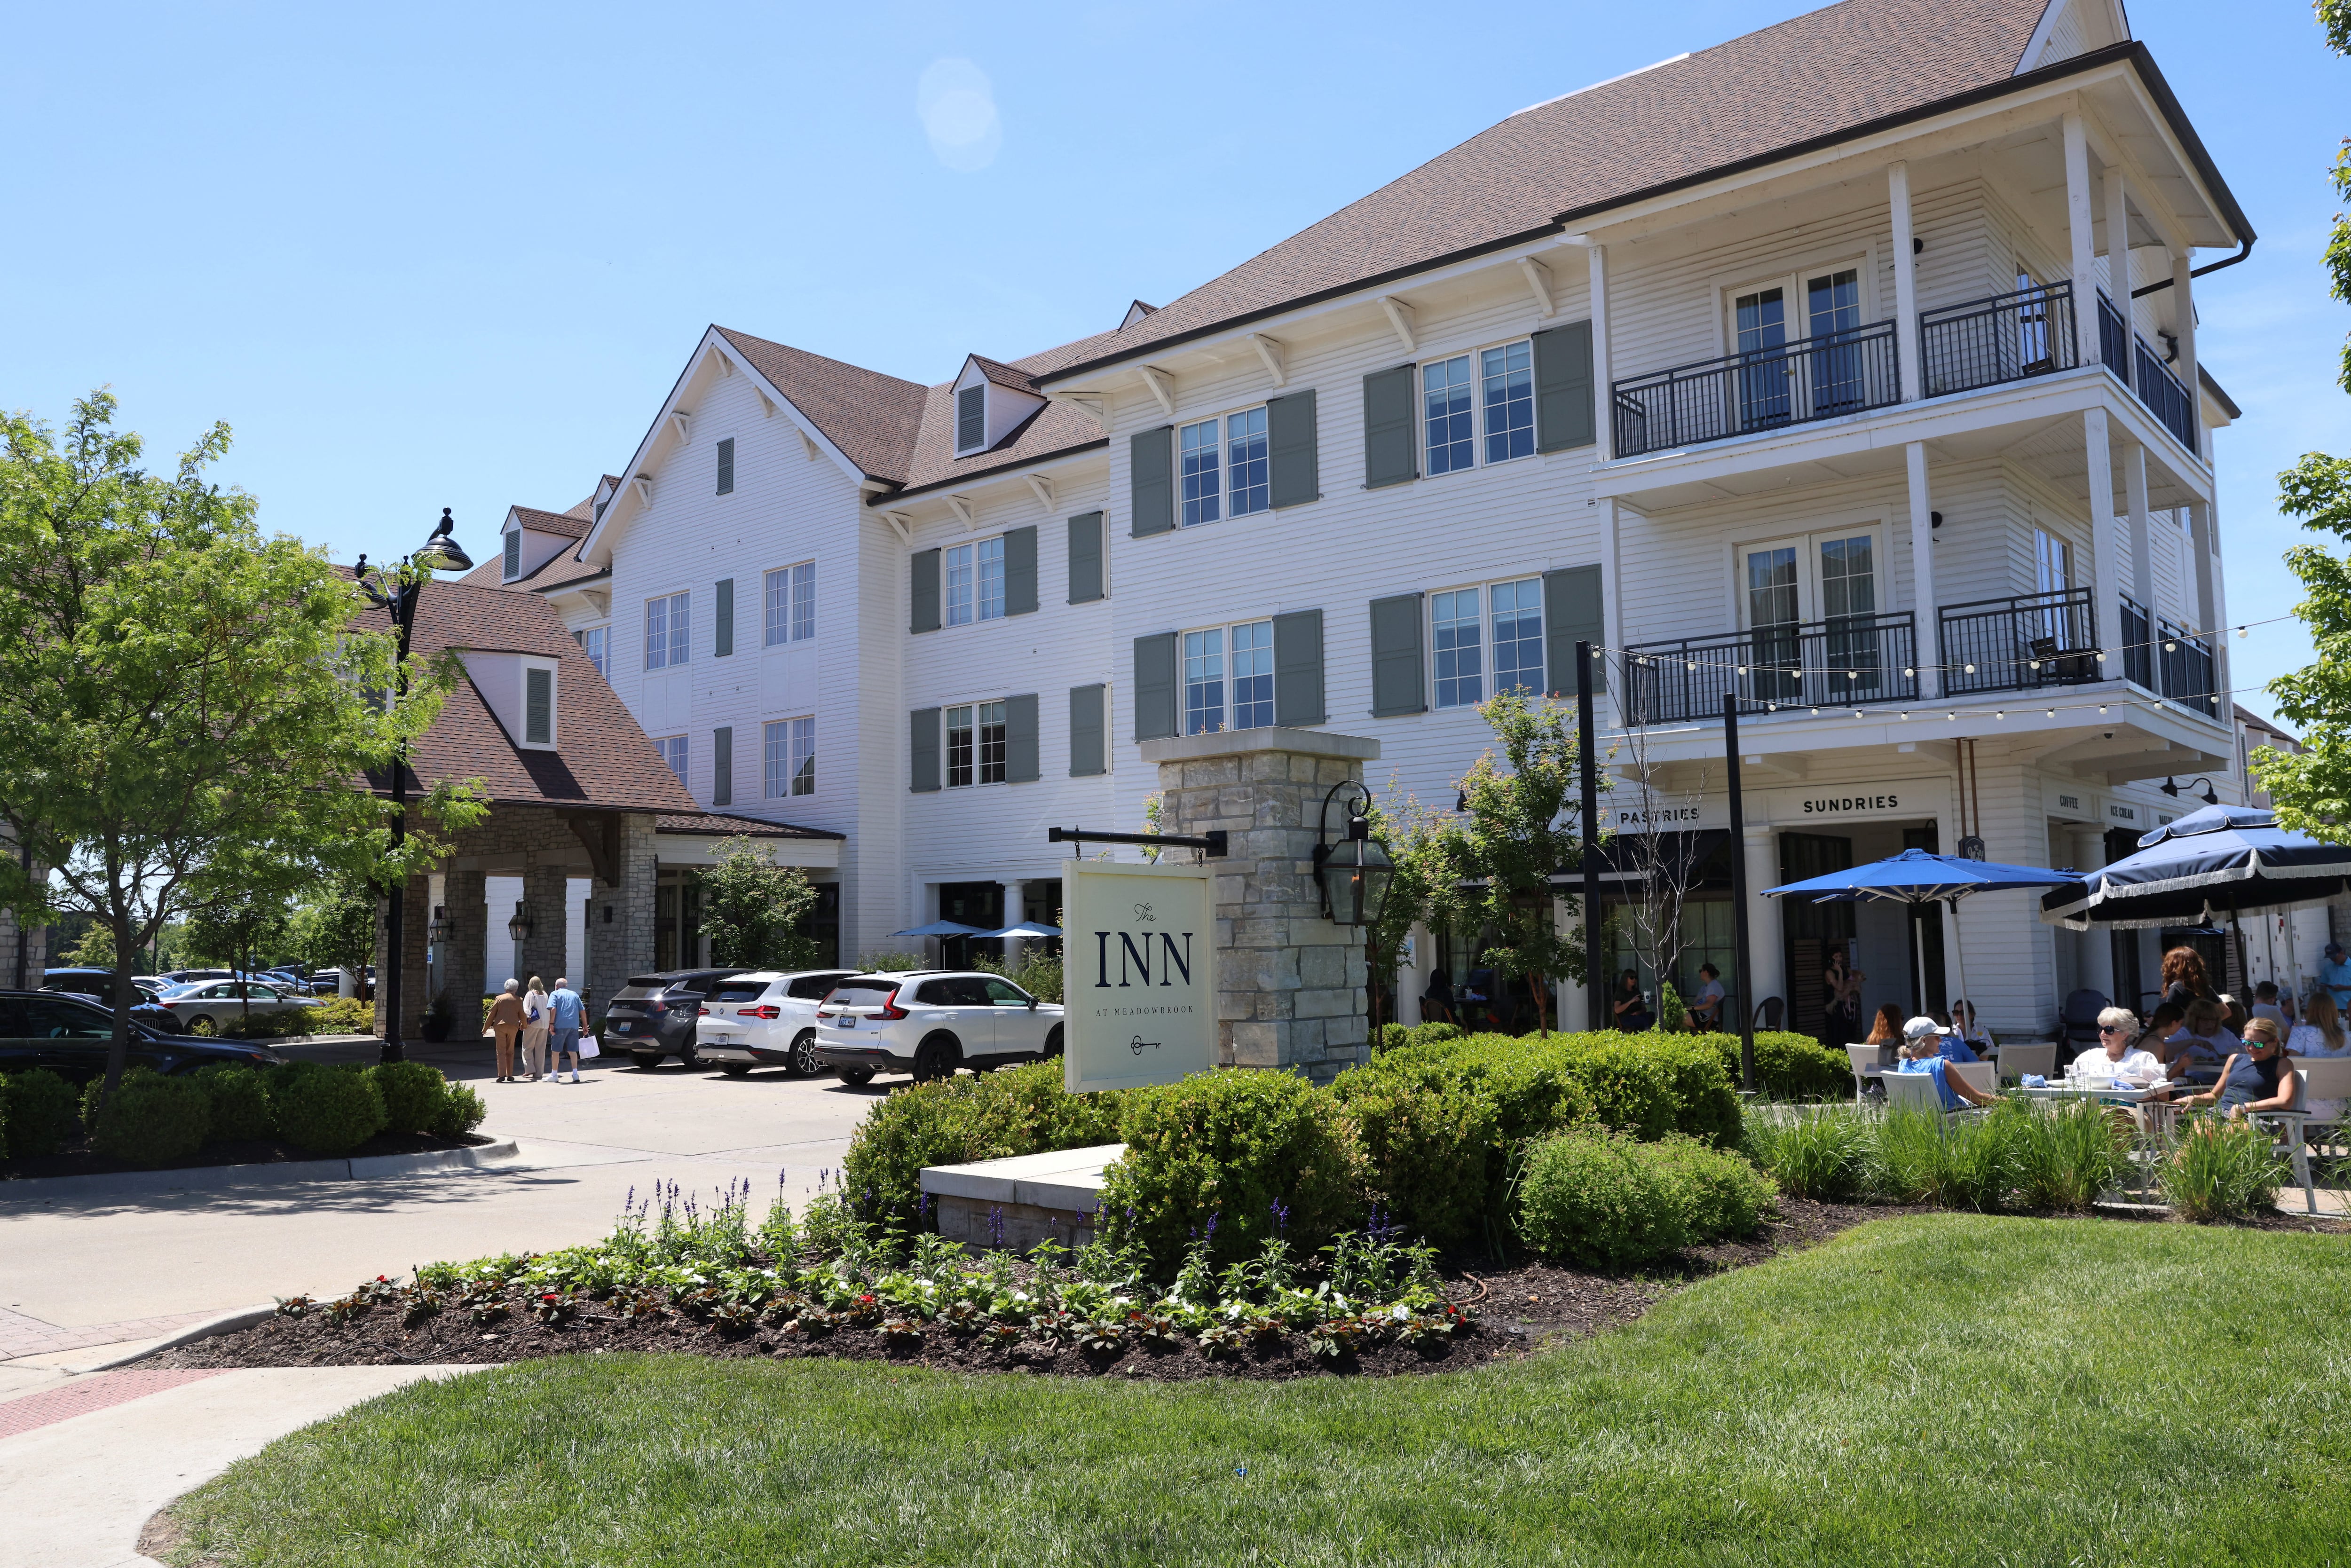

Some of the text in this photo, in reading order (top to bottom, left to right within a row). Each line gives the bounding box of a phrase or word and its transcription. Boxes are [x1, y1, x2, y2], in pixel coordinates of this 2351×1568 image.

[1804, 795, 1898, 813] SUNDRIES
[2060, 795, 2078, 809] COFFEE
[1621, 808, 1699, 824] PASTRIES
[2119, 806, 2134, 819] CREAM
[1134, 902, 1157, 922] The
[1095, 932, 1193, 987] INN
[1114, 1006, 1193, 1016] MEADOWBROOK
